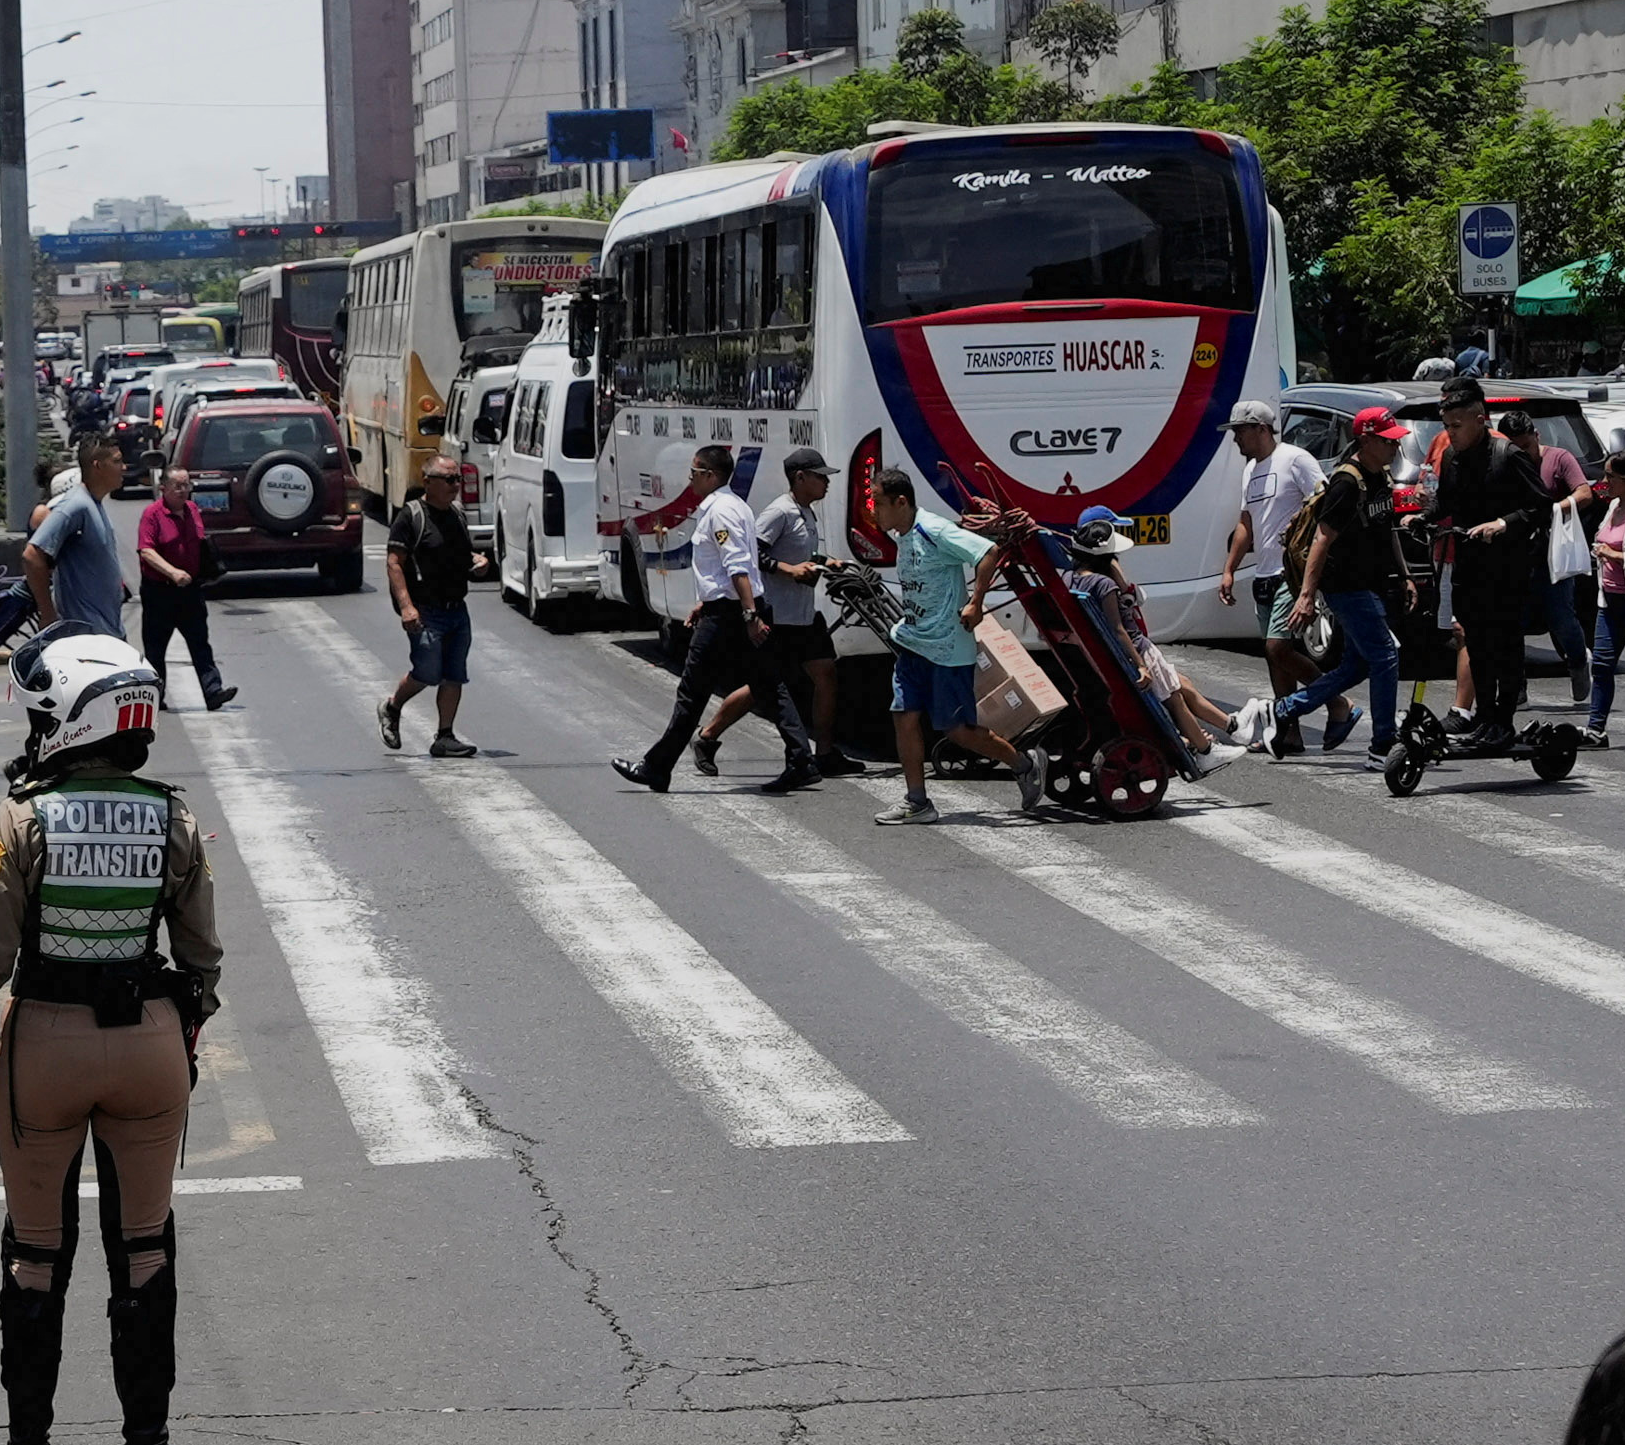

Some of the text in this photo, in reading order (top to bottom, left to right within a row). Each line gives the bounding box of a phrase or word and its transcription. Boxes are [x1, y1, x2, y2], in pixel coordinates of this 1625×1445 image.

[952, 169, 1031, 192] Kamila
[1066, 165, 1152, 183] Matteo
[503, 254, 574, 265] SE NECESITAN
[1476, 263, 1504, 274] SOLO
[1472, 276, 1508, 288] BUSES
[966, 350, 1054, 368] TRANSPORTES
[1063, 339, 1145, 372] HUASCAR
[1195, 349, 1216, 362] 2241
[1100, 427, 1122, 454] 7
[266, 481, 307, 491] SUZUKI
[114, 689, 155, 705] POLICIA
[42, 723, 93, 756] Lima Centro
[46, 801, 163, 835] POLICIA
[47, 844, 164, 878] TRANSITO
